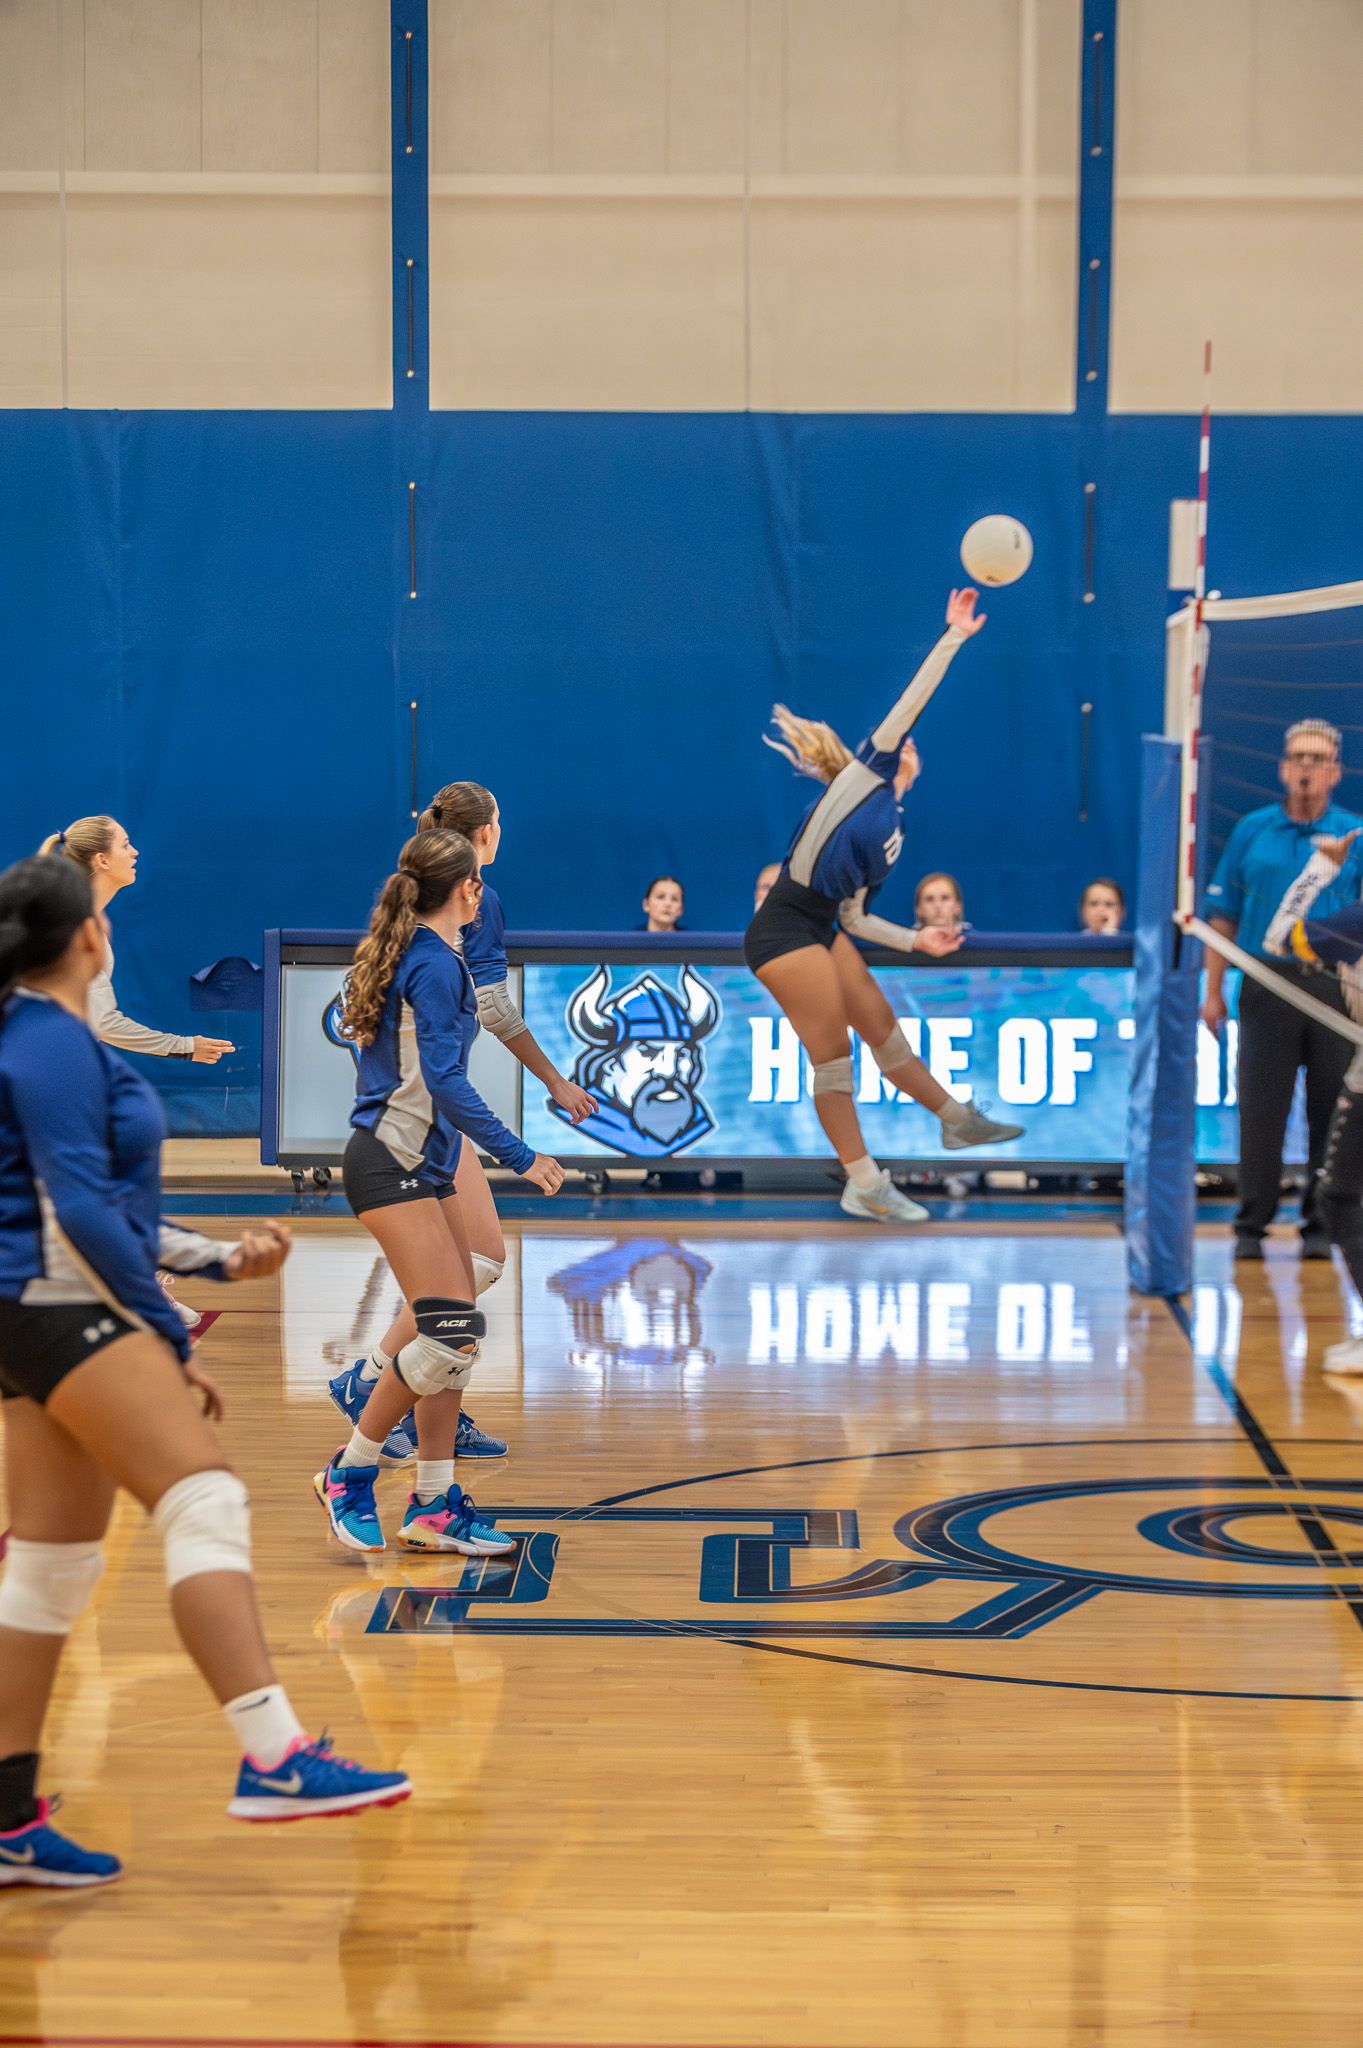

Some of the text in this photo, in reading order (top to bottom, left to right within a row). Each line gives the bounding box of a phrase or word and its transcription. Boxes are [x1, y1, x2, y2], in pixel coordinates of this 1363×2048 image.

[748, 1017, 973, 1104] HE
[997, 1017, 1098, 1105] OF
[435, 1320, 469, 1329] ACE
